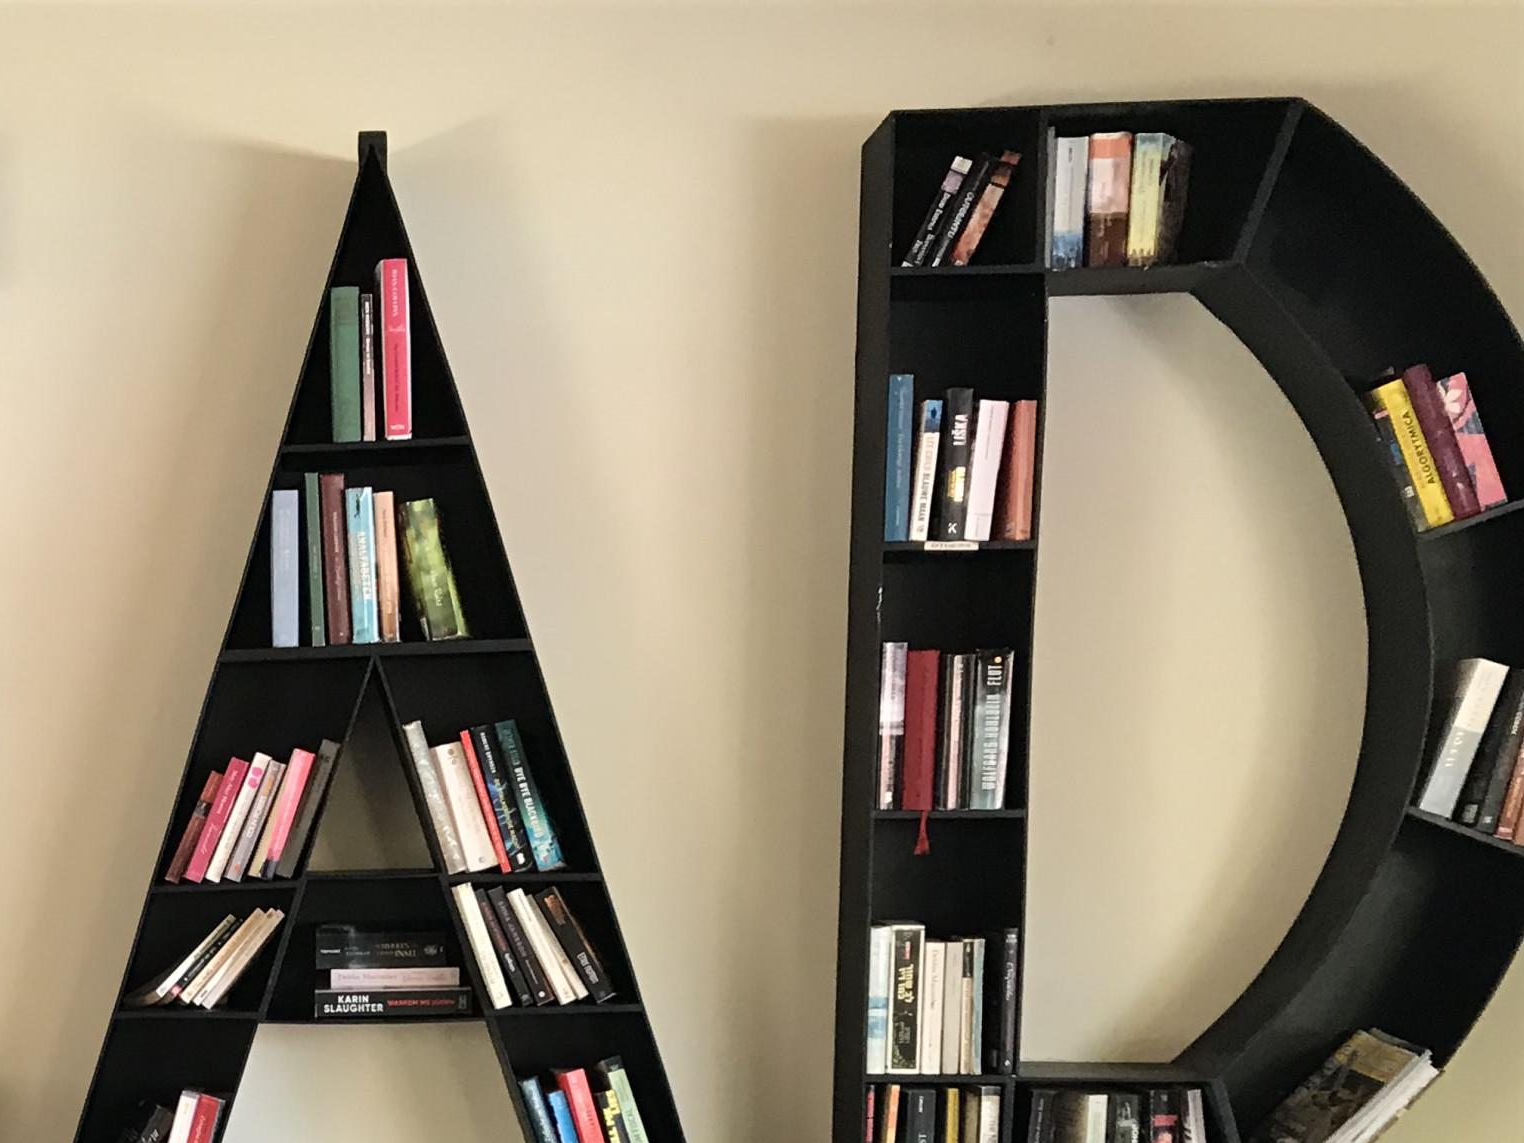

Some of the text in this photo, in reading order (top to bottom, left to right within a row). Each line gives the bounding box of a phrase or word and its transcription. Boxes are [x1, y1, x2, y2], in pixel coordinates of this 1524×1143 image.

[951, 414, 970, 446] LIŠKA
[1402, 411, 1436, 484] ALGORYTMICA
[919, 472, 932, 501] BLAUWE
[916, 501, 927, 522] MAAN
[987, 665, 1003, 686] FLUT
[513, 765, 544, 839] BYE BYE BLACKBIRD
[496, 898, 528, 959] ANNA JANSSON
[323, 1003, 384, 1013] SLAUGHTER
[337, 994, 370, 1004] KARIN
[623, 1106, 640, 1134] FISCAL
